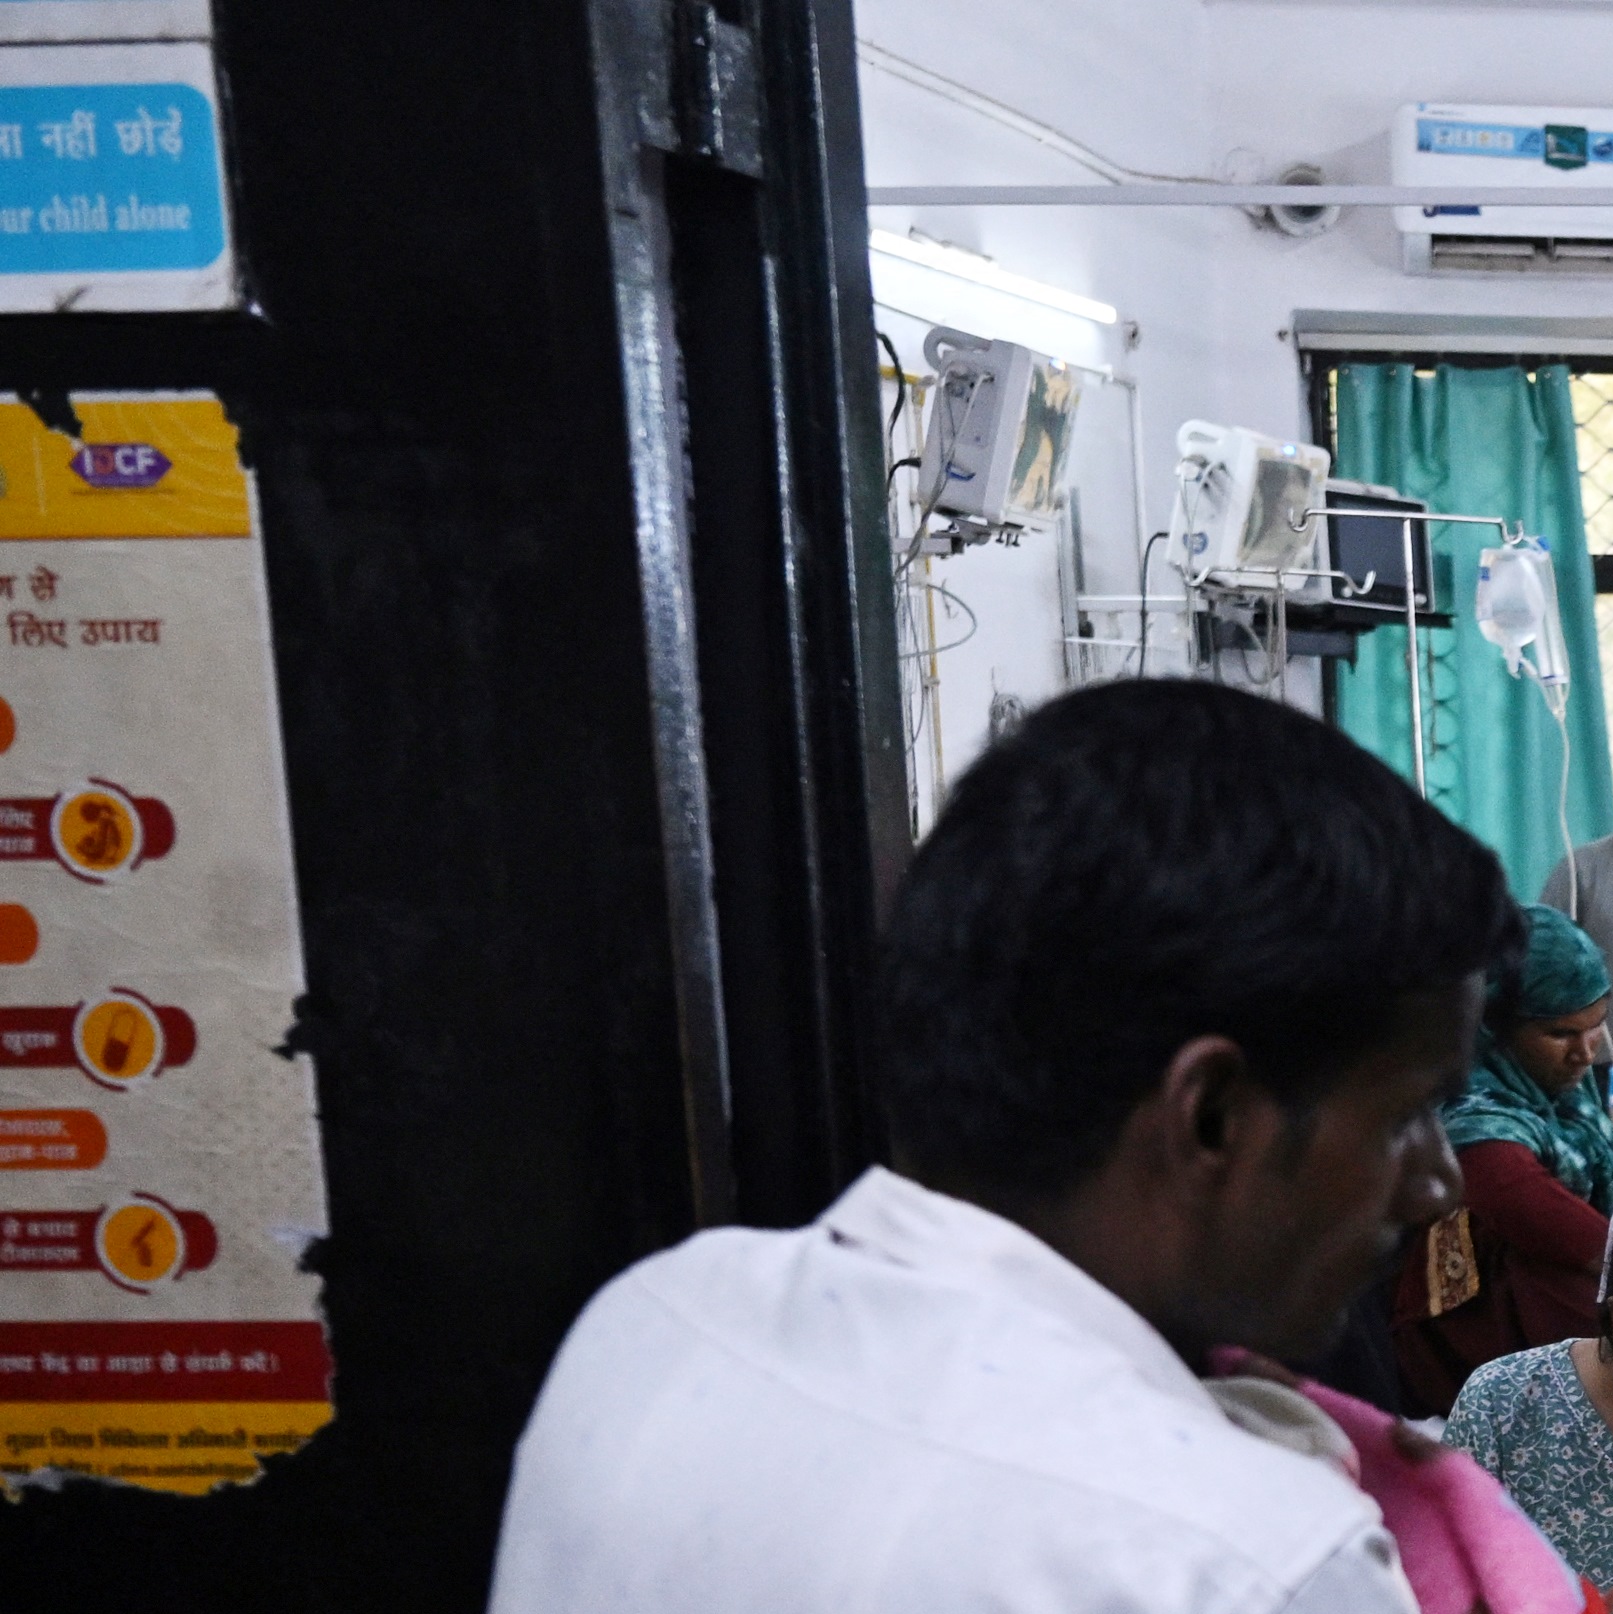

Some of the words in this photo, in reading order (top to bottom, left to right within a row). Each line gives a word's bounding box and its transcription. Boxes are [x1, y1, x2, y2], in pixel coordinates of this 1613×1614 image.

[39, 195, 108, 232] child
[115, 195, 190, 231] alone
[8, 611, 68, 649] लिए
[78, 617, 164, 647] उपाय
